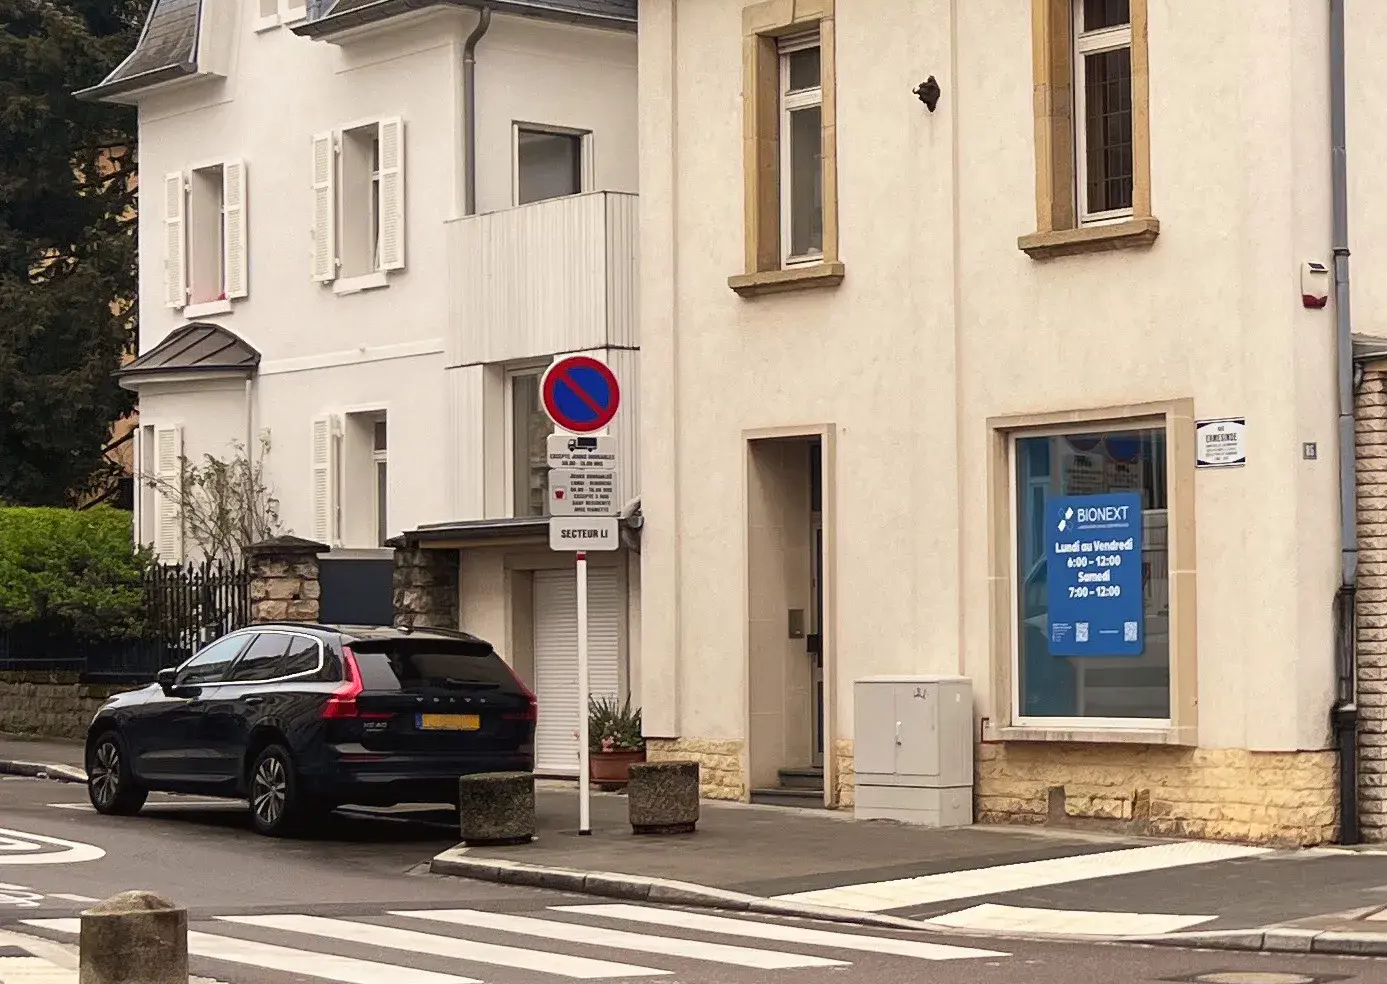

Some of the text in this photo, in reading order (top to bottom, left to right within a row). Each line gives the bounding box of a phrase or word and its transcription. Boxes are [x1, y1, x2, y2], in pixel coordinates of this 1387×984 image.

[1077, 506, 1129, 522] BIONEXT
[560, 529, 608, 538] SECTEUR LI
[1055, 537, 1133, 553] Lundi au Vendredi
[1067, 556, 1087, 568] 6:00
[1096, 555, 1121, 567] 12:00
[1078, 569, 1110, 582] Samedi
[1068, 586, 1088, 598] 7:00
[1096, 585, 1121, 597] 12:00
